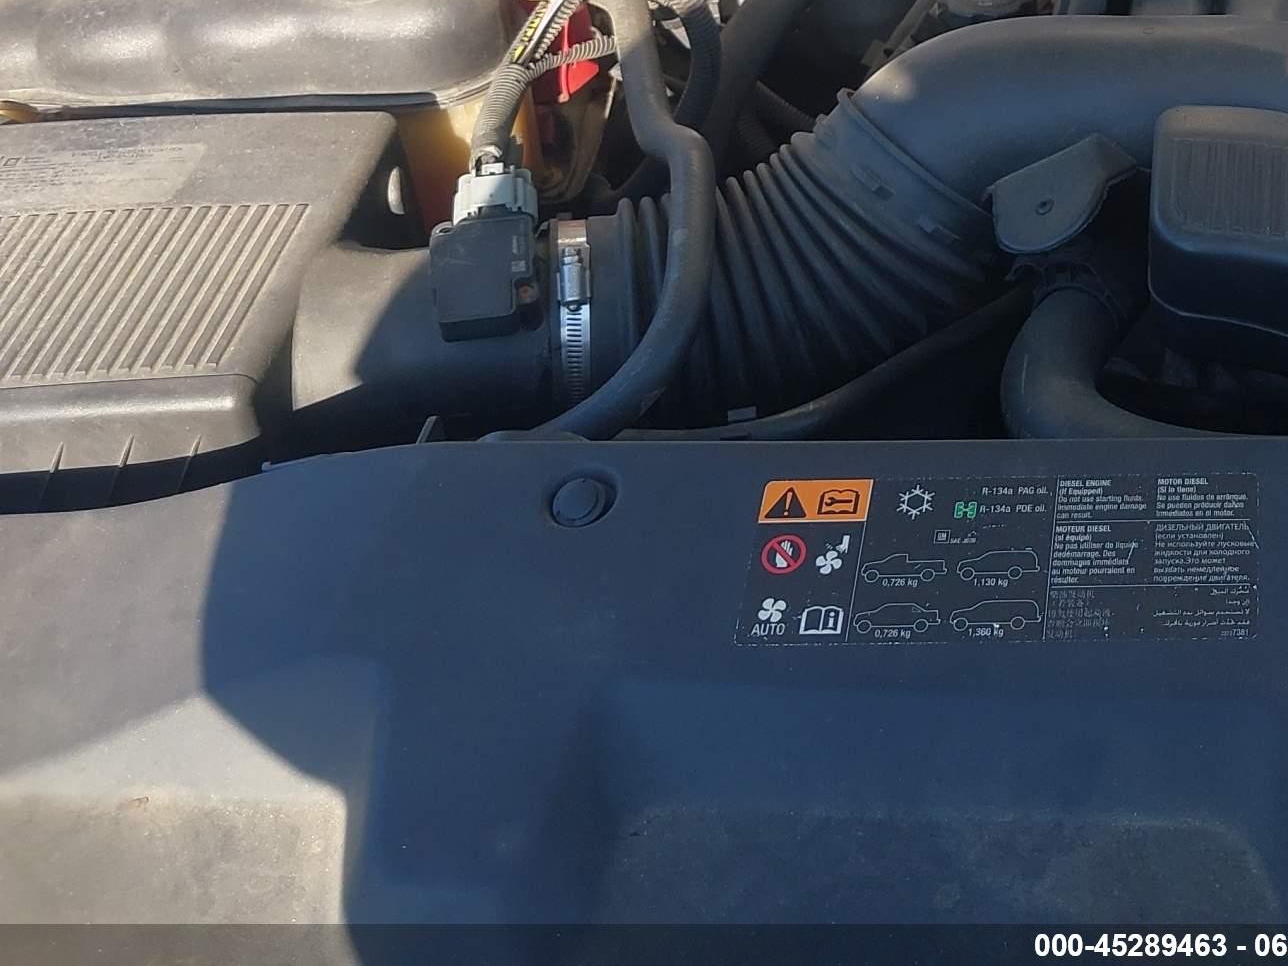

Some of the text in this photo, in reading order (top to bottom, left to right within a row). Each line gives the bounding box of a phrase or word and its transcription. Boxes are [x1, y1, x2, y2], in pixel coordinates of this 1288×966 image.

[982, 487, 1013, 495] R-134a
[1018, 487, 1034, 495] PAG
[980, 505, 1011, 513] R-134a
[1155, 523, 1249, 531] ДИЗЕЛЬНЫЙ ДВИГАТЕЛЬ
[1167, 540, 1215, 548] используйте
[907, 578, 918, 587] kg
[997, 578, 1008, 587] kg
[751, 623, 785, 635] AUTO
[993, 627, 1004, 637] kg
[900, 629, 911, 639] kg
